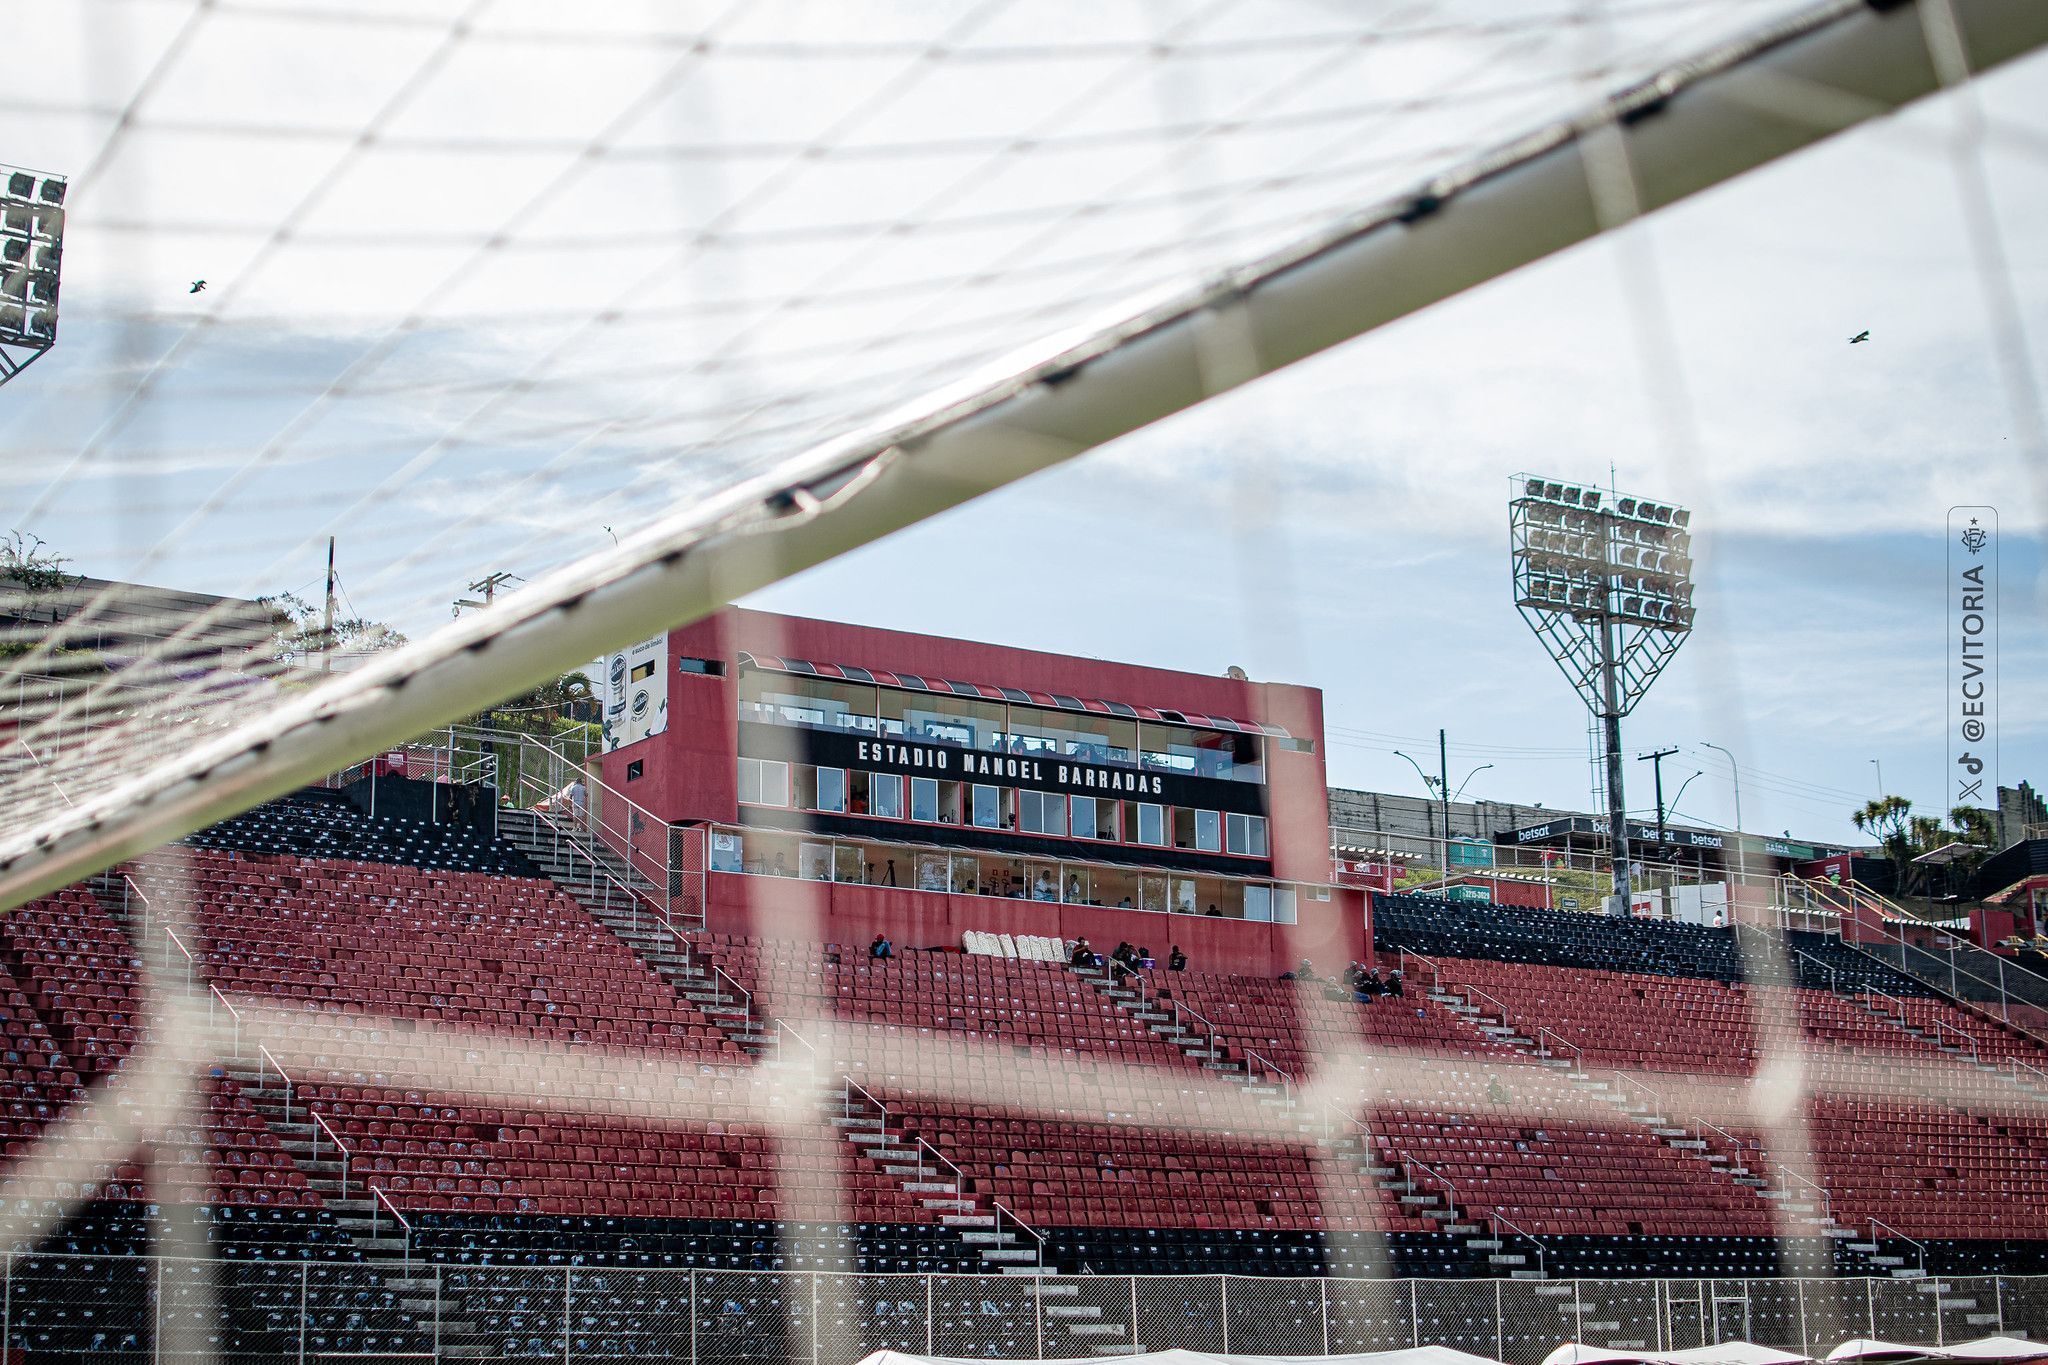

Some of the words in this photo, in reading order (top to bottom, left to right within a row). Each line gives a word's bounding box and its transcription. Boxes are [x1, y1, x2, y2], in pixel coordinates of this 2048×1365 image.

[858, 741, 947, 769] ESTADIO
[963, 753, 1043, 781] MANOEL
[1058, 765, 1162, 794] BARRADAS
[1518, 824, 1550, 841] betsat
[1642, 826, 1675, 841] betat
[1691, 833, 1723, 848] betsat
[1765, 842, 1790, 854] SAÍDA
